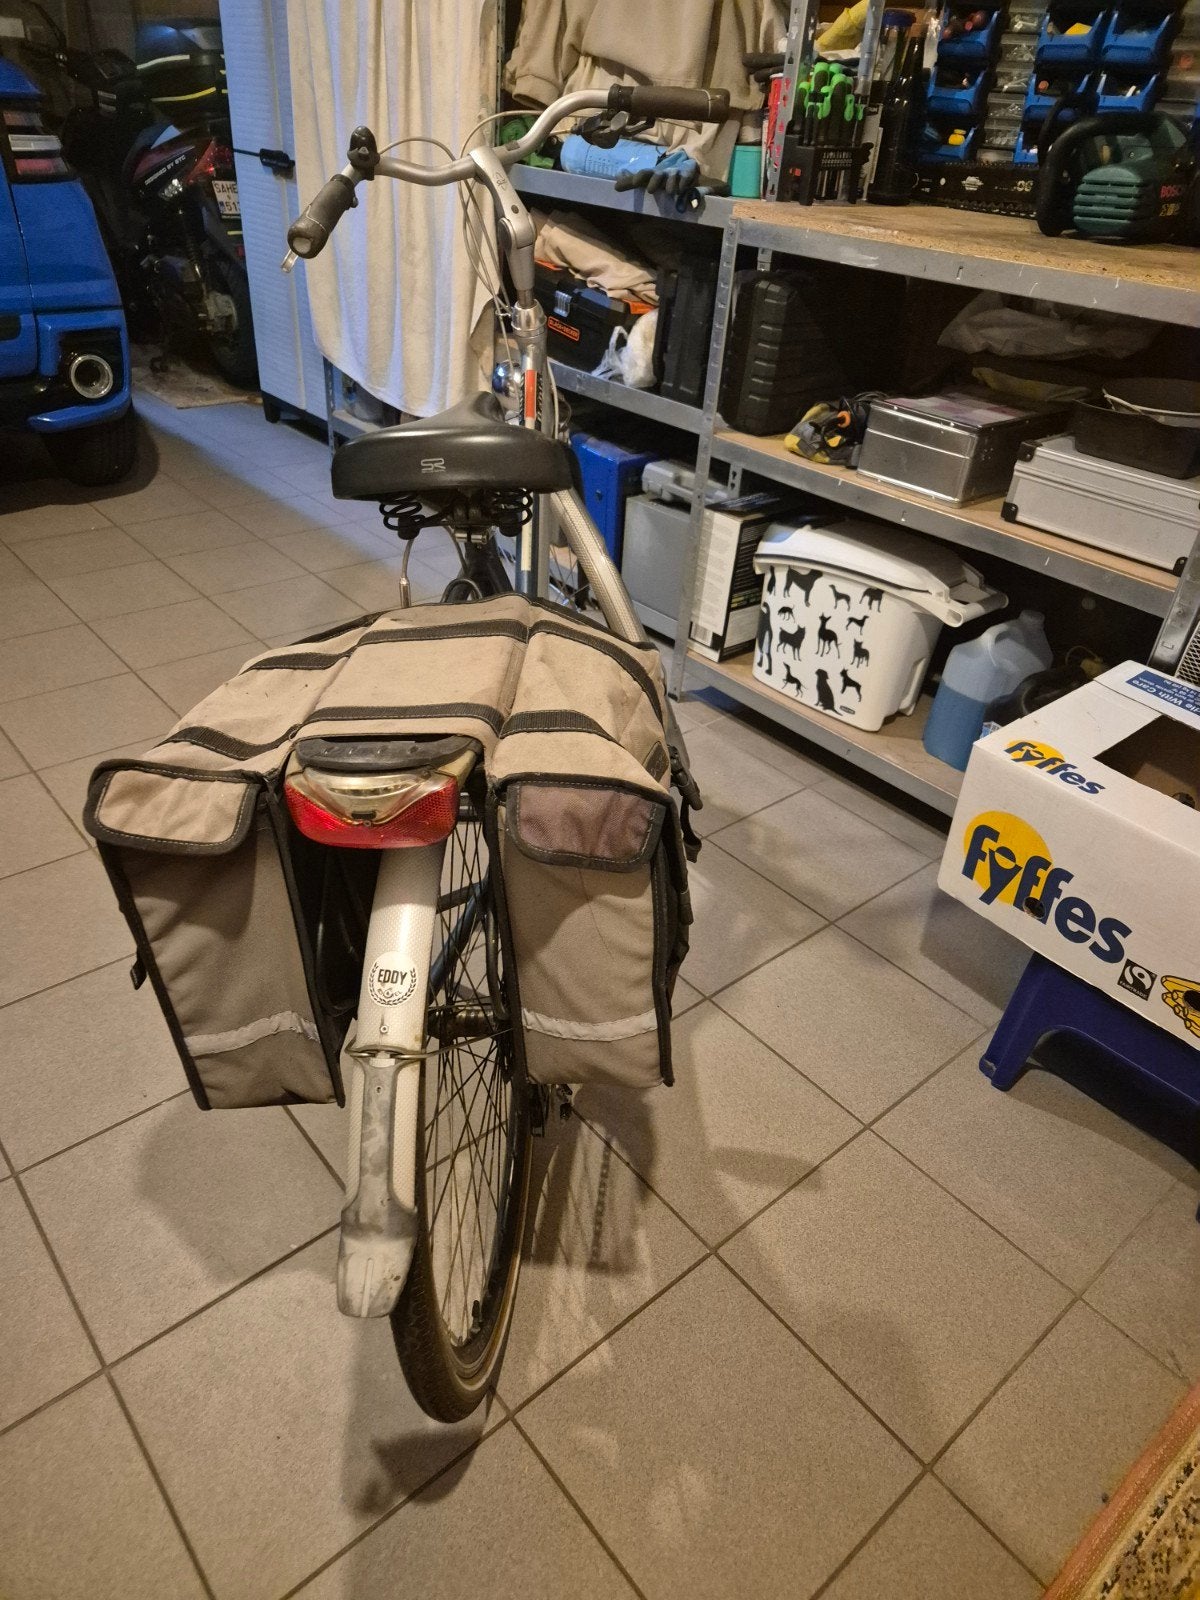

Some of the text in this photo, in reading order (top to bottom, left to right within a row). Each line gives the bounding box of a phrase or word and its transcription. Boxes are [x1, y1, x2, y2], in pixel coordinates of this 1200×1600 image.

[1131, 679, 1157, 693] Care
[1158, 691, 1182, 706] With
[377, 968, 407, 985] EDDY
